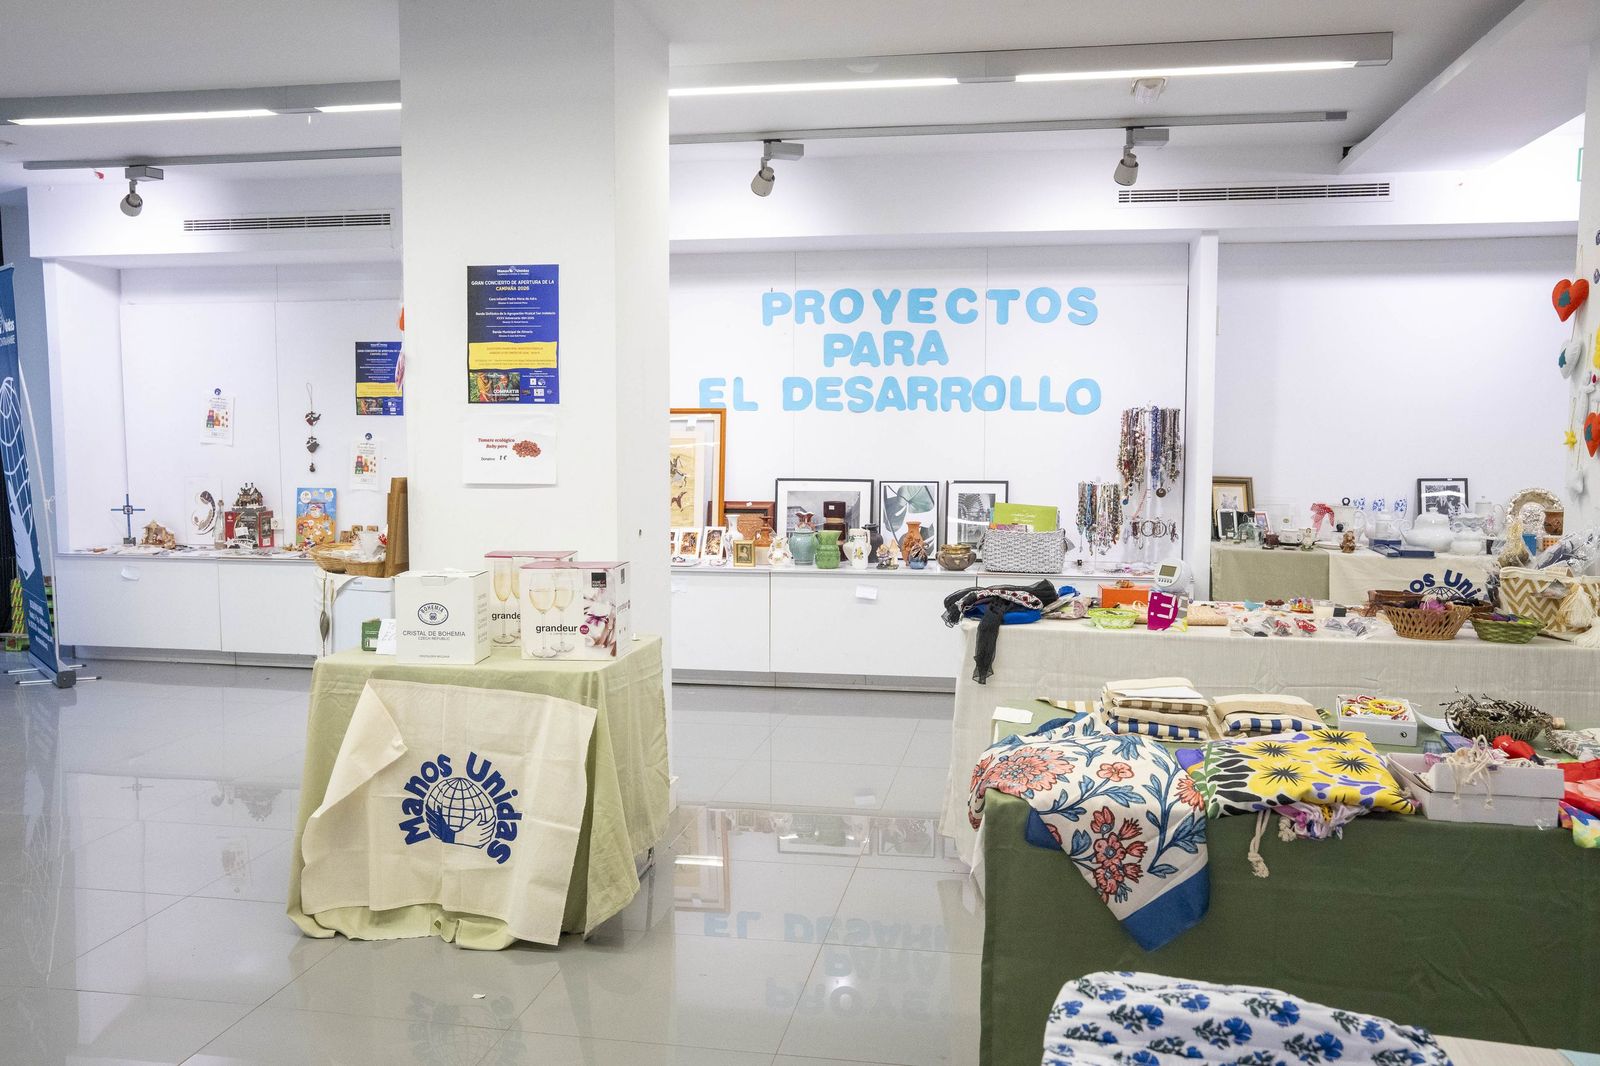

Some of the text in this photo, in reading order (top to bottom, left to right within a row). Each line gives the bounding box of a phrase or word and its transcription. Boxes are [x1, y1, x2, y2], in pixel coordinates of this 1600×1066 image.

[762, 287, 1098, 326] PROYECTOS
[823, 330, 949, 367] PARA
[699, 375, 1101, 415] EL DESARROLLO
[420, 604, 445, 614] BOHEMIA
[536, 624, 578, 633] grandeur
[399, 751, 523, 864] Manos Unidas
